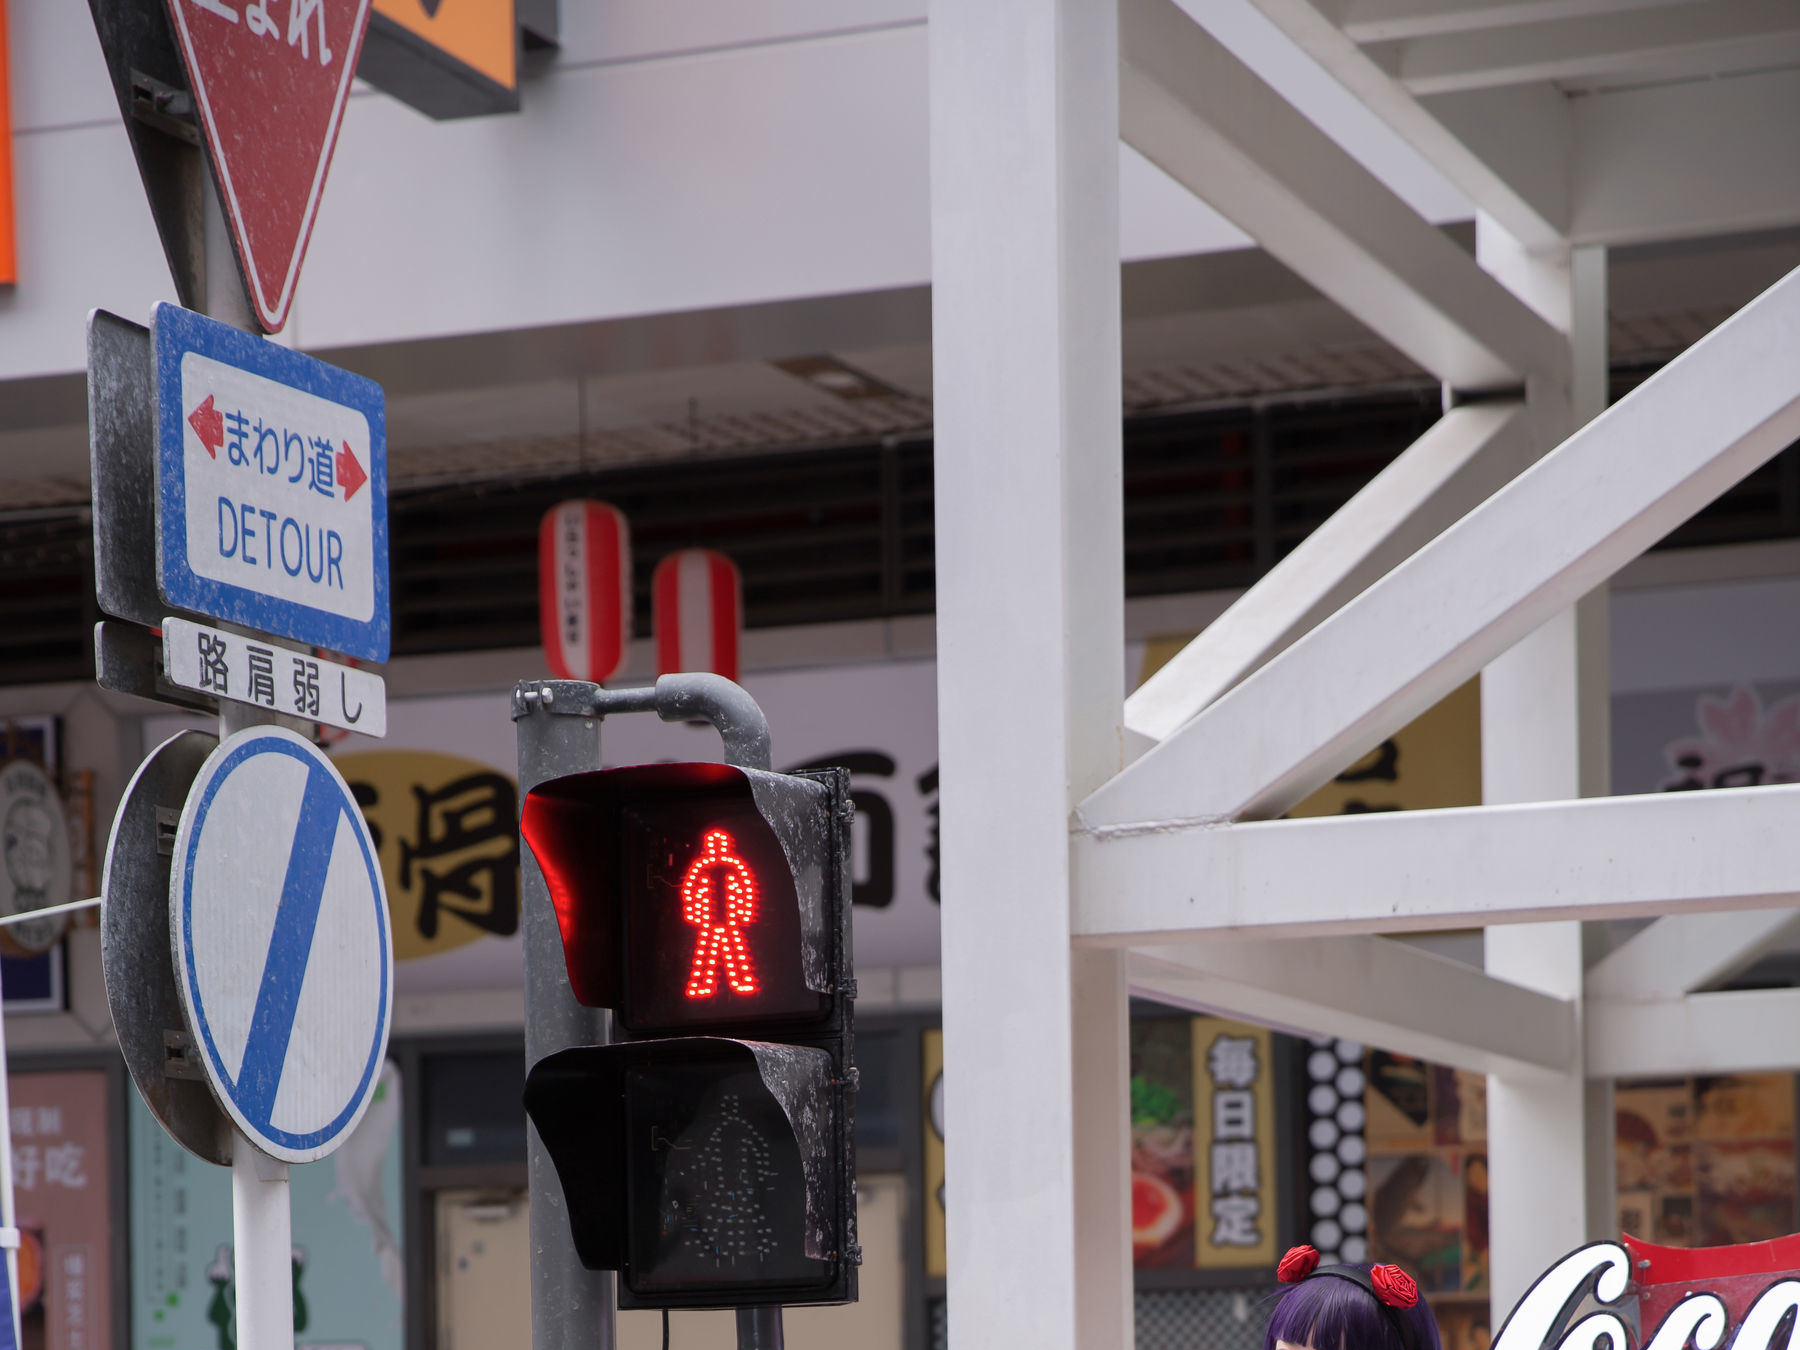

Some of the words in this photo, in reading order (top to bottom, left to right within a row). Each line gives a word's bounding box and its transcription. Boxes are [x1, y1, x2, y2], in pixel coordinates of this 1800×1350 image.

[224, 409, 335, 498] まわり道
[217, 496, 343, 590] DETOUR
[197, 631, 362, 724] 路肩弱し
